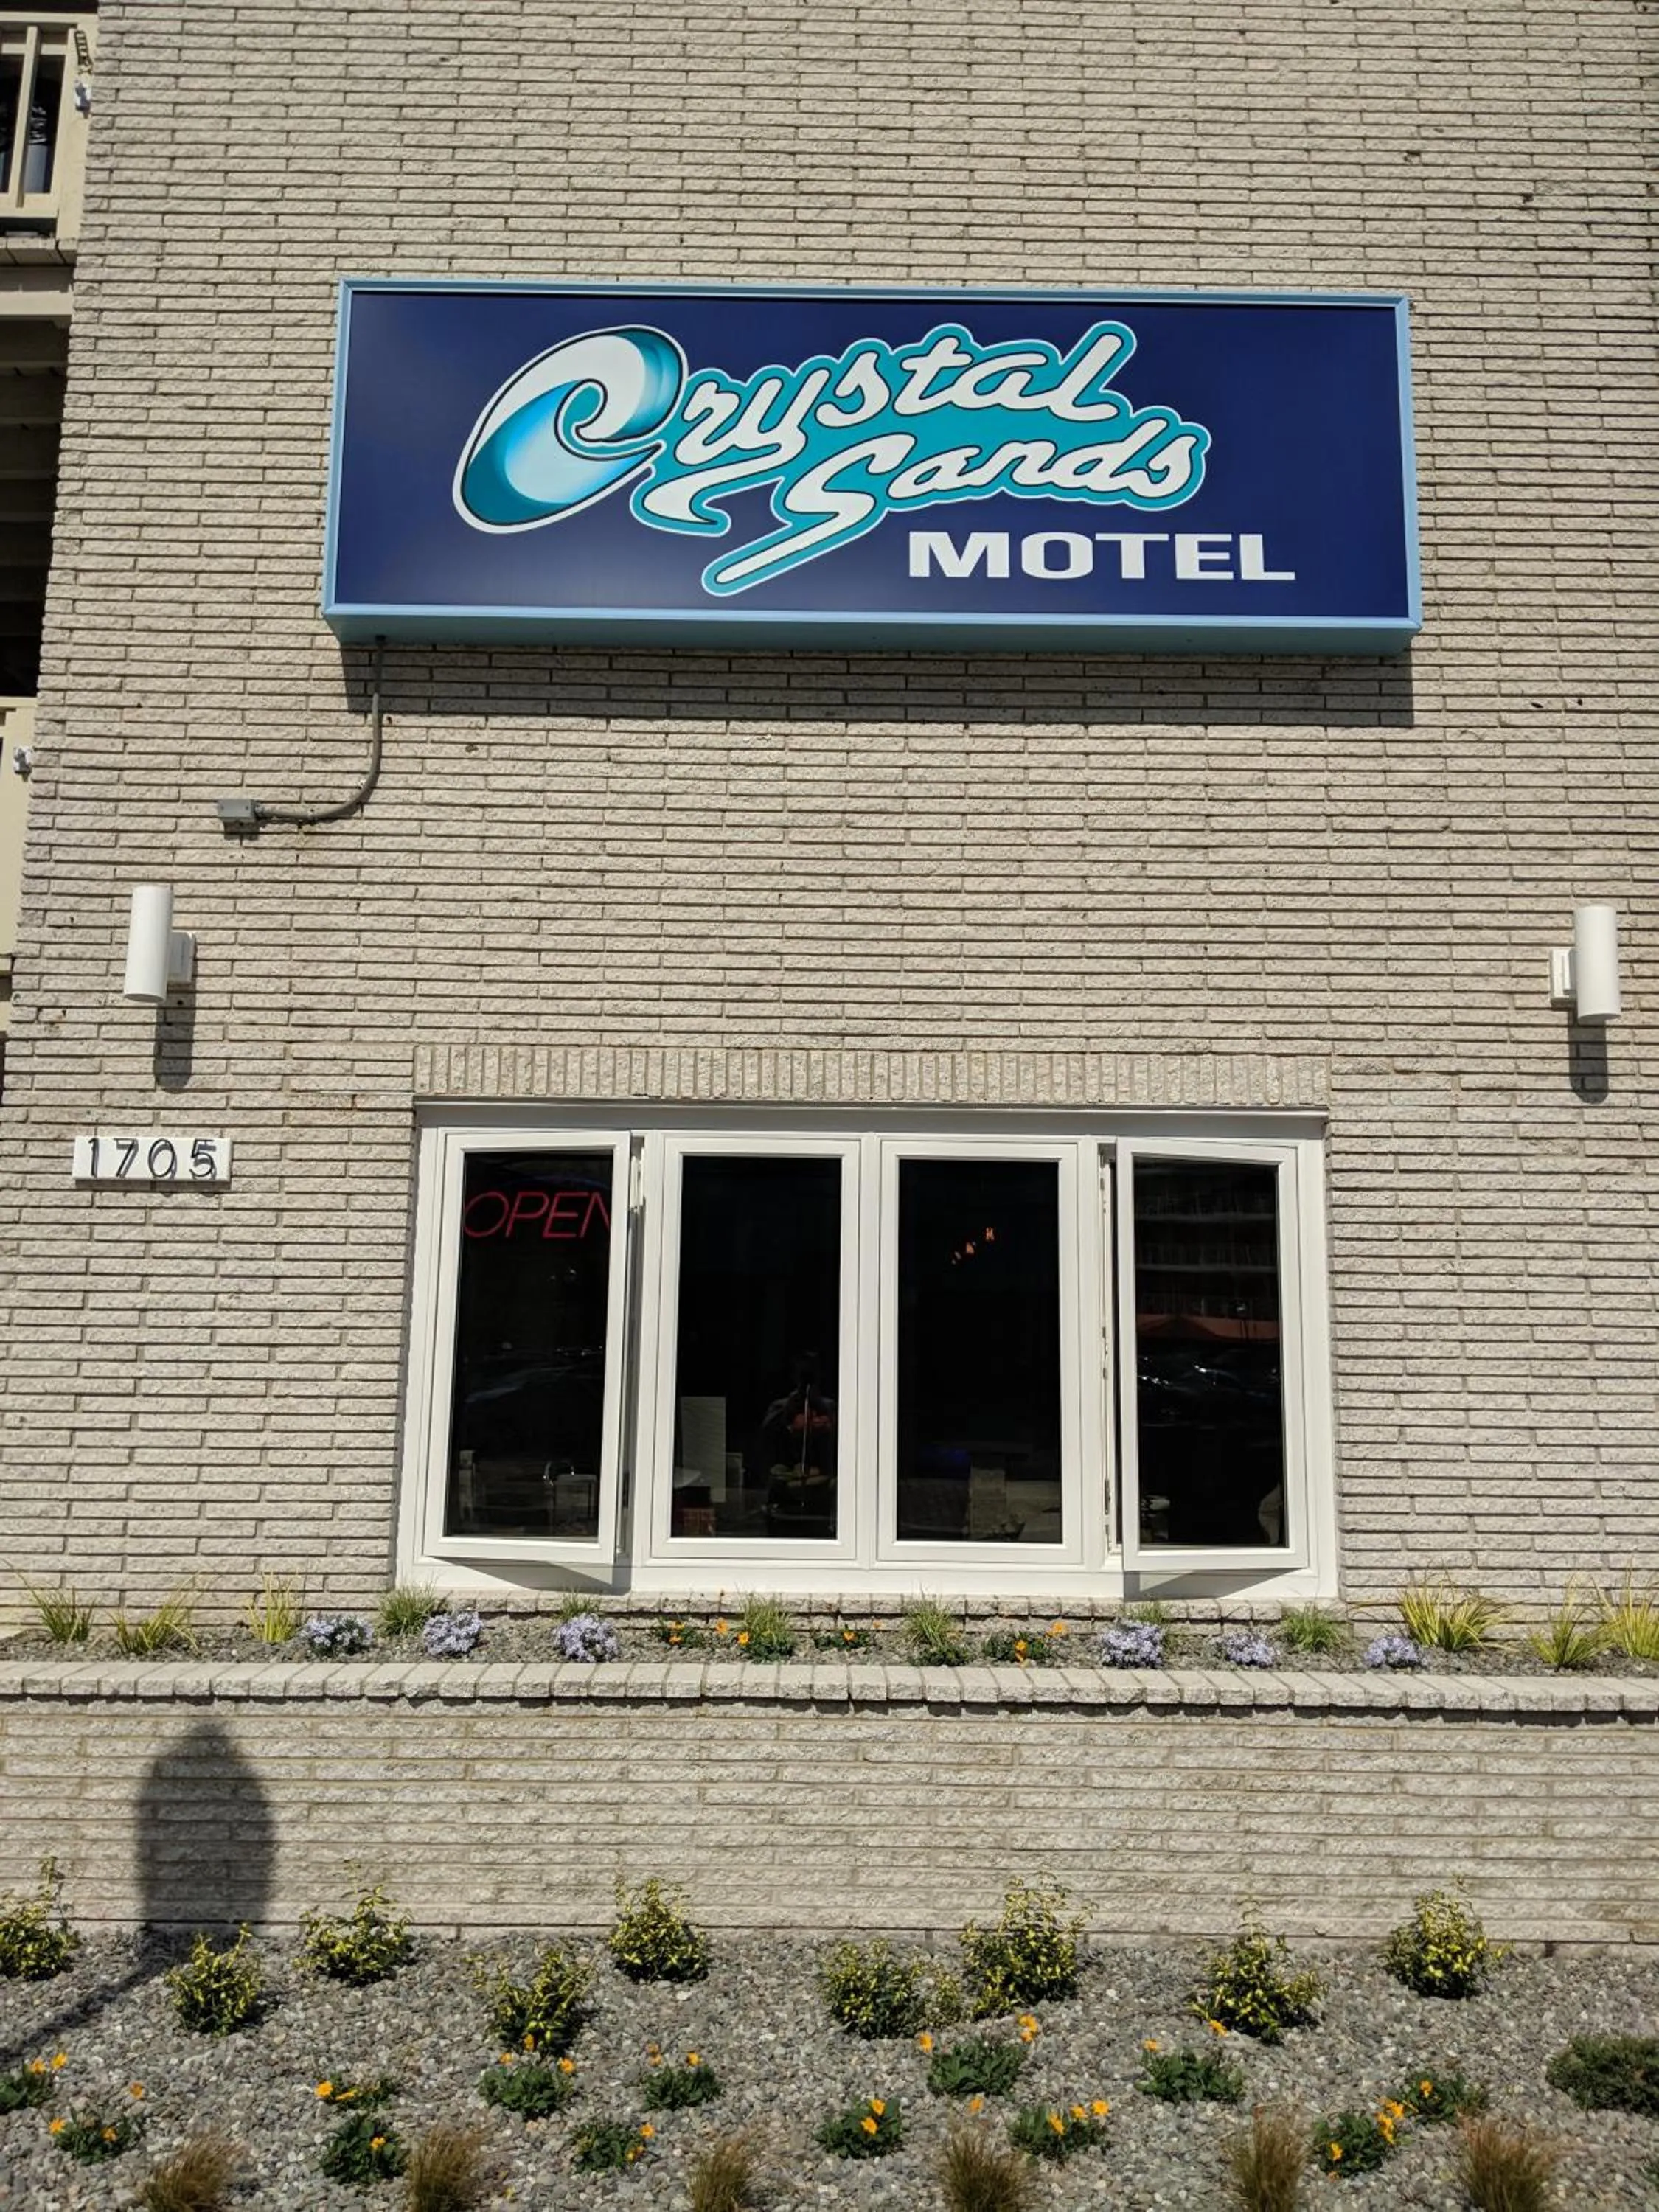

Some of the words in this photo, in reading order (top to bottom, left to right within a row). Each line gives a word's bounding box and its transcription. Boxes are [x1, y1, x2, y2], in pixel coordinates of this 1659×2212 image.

[453, 323, 1135, 536] Crystal
[703, 411, 1208, 595] Sands
[908, 530, 1296, 581] MOTEL
[88, 1138, 216, 1178] 1705
